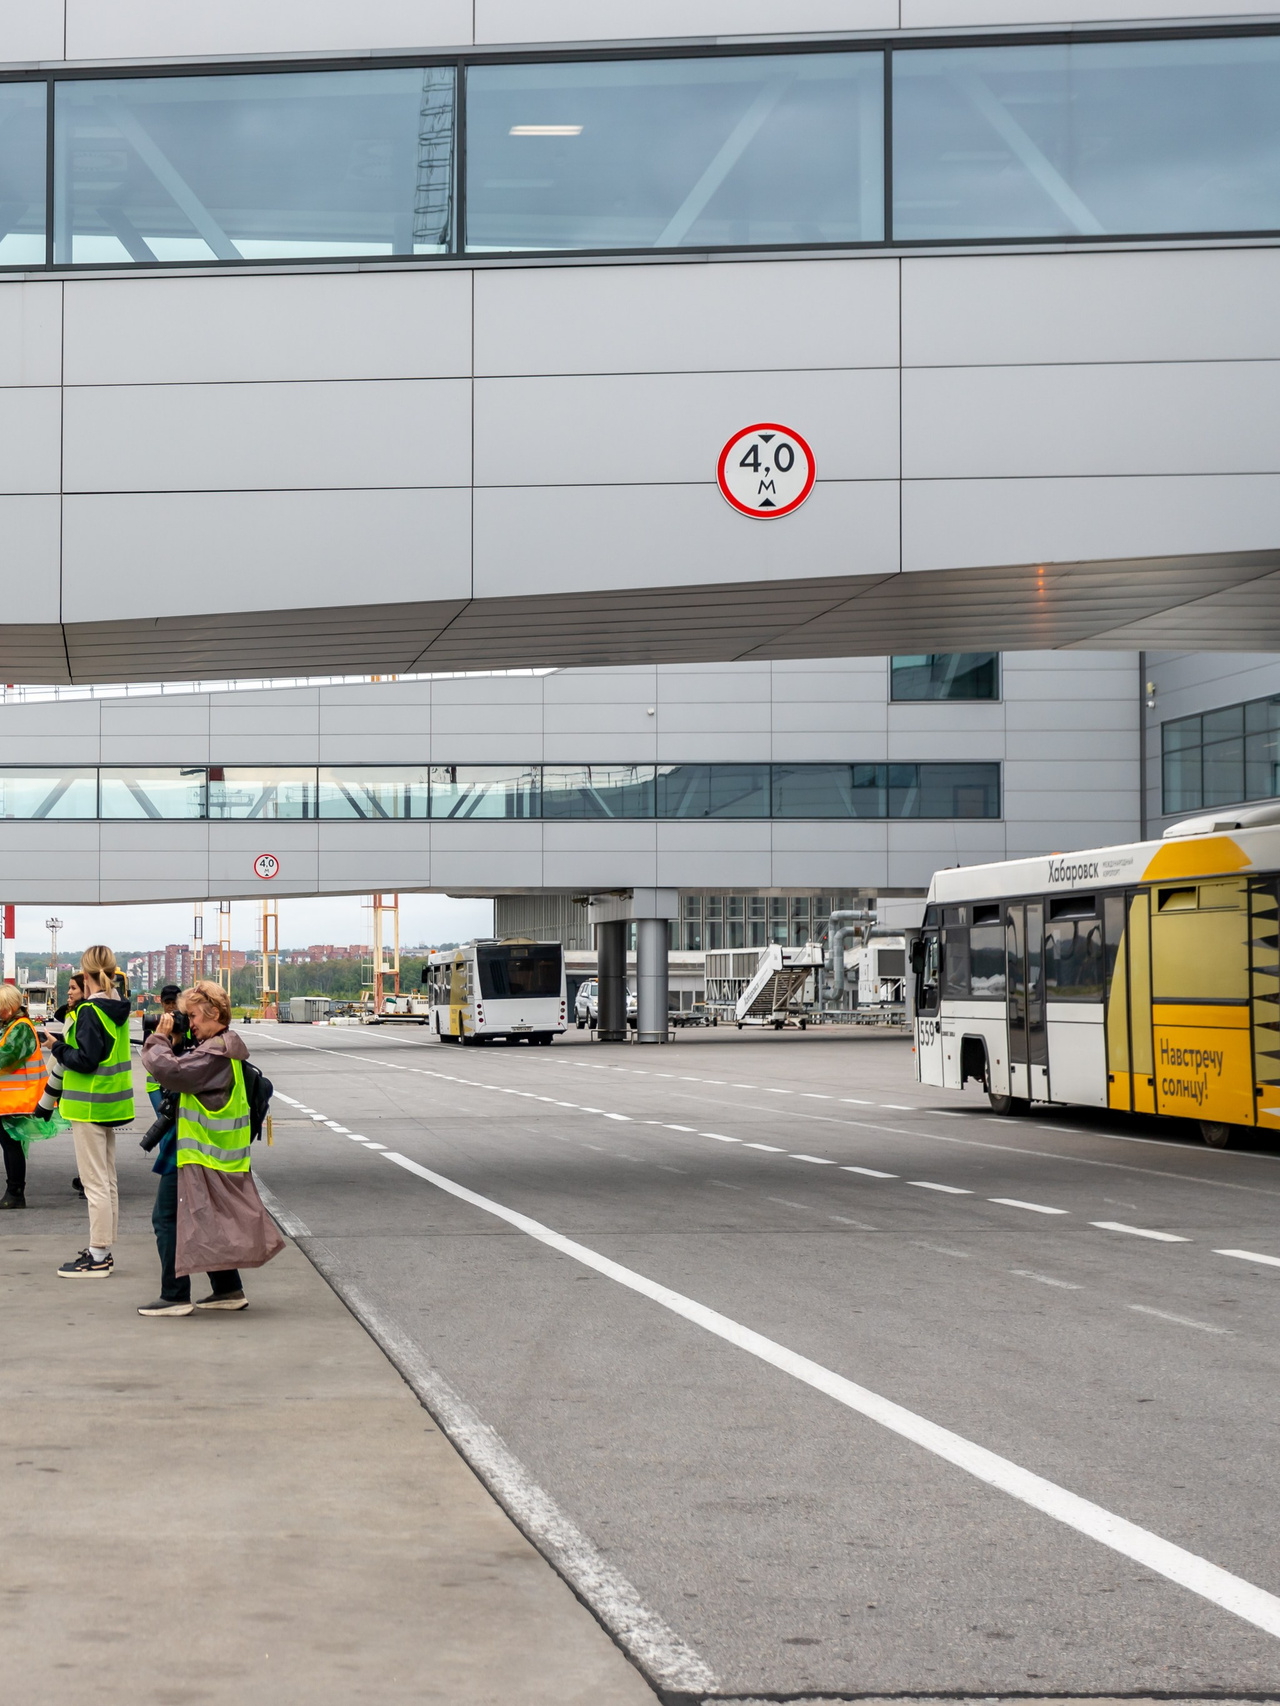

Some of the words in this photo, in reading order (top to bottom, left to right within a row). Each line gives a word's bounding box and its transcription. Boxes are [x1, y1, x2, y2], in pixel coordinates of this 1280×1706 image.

[739, 442, 795, 477] 4,0
[1048, 858, 1099, 888] Хабаровск
[920, 1020, 935, 1047] 559
[1160, 1038, 1224, 1077] Навстречу
[1162, 1072, 1209, 1107] солнцу!
